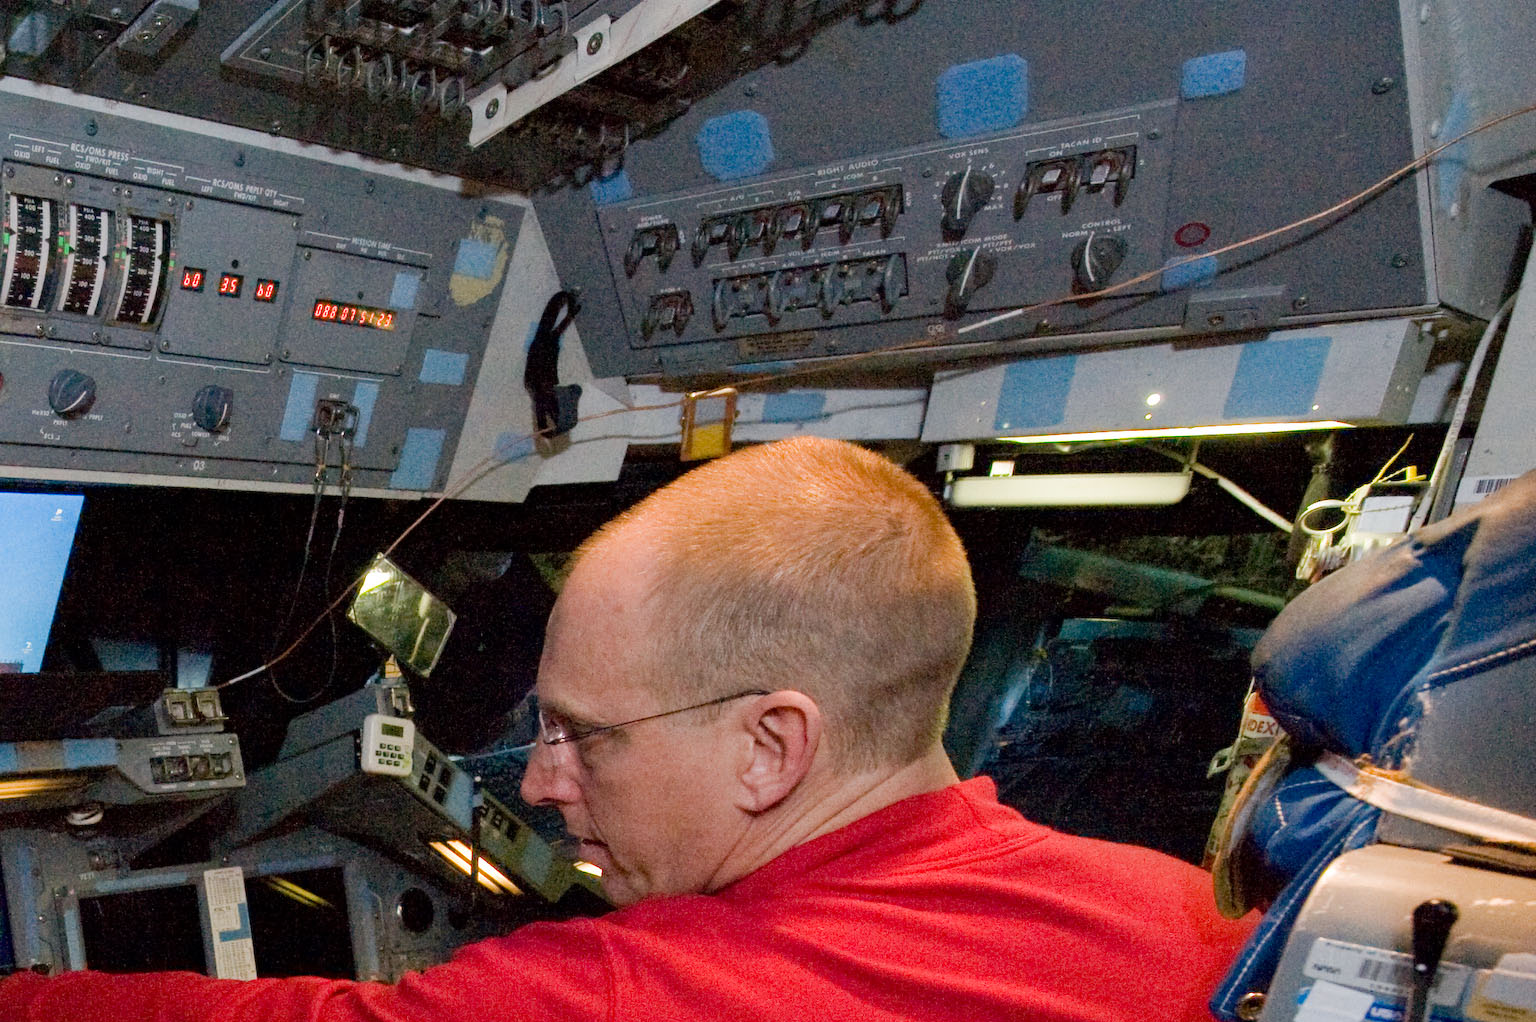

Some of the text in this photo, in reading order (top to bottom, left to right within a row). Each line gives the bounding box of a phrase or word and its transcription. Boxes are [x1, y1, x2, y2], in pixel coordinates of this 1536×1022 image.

[1060, 138, 1089, 150] TACAN
[31, 145, 45, 154] LEFT
[70, 143, 129, 162] RCS/OMS PRESS
[948, 147, 989, 160] VOX SENS
[1049, 150, 1063, 158] ON
[14, 150, 31, 160] OXID
[46, 156, 60, 165] FUEL
[75, 161, 91, 170] OXID
[817, 159, 879, 176] RIGHT AUDIO
[105, 167, 119, 176] FUEL
[147, 167, 165, 176] RIGHT
[133, 172, 148, 181] OXID
[843, 172, 864, 181] ICOM
[162, 178, 175, 187] FUEL
[212, 178, 244, 193] RCS/OMS
[264, 188, 278, 199] QTY
[983, 203, 1004, 211] MAX
[1082, 218, 1122, 229] CONTROL
[1113, 223, 1132, 232] LEFT
[1061, 230, 1089, 239] NORM
[220, 277, 238, 293] 35
[314, 303, 338, 319] 088
[340, 307, 356, 321] 07
[376, 313, 393, 327] 23
